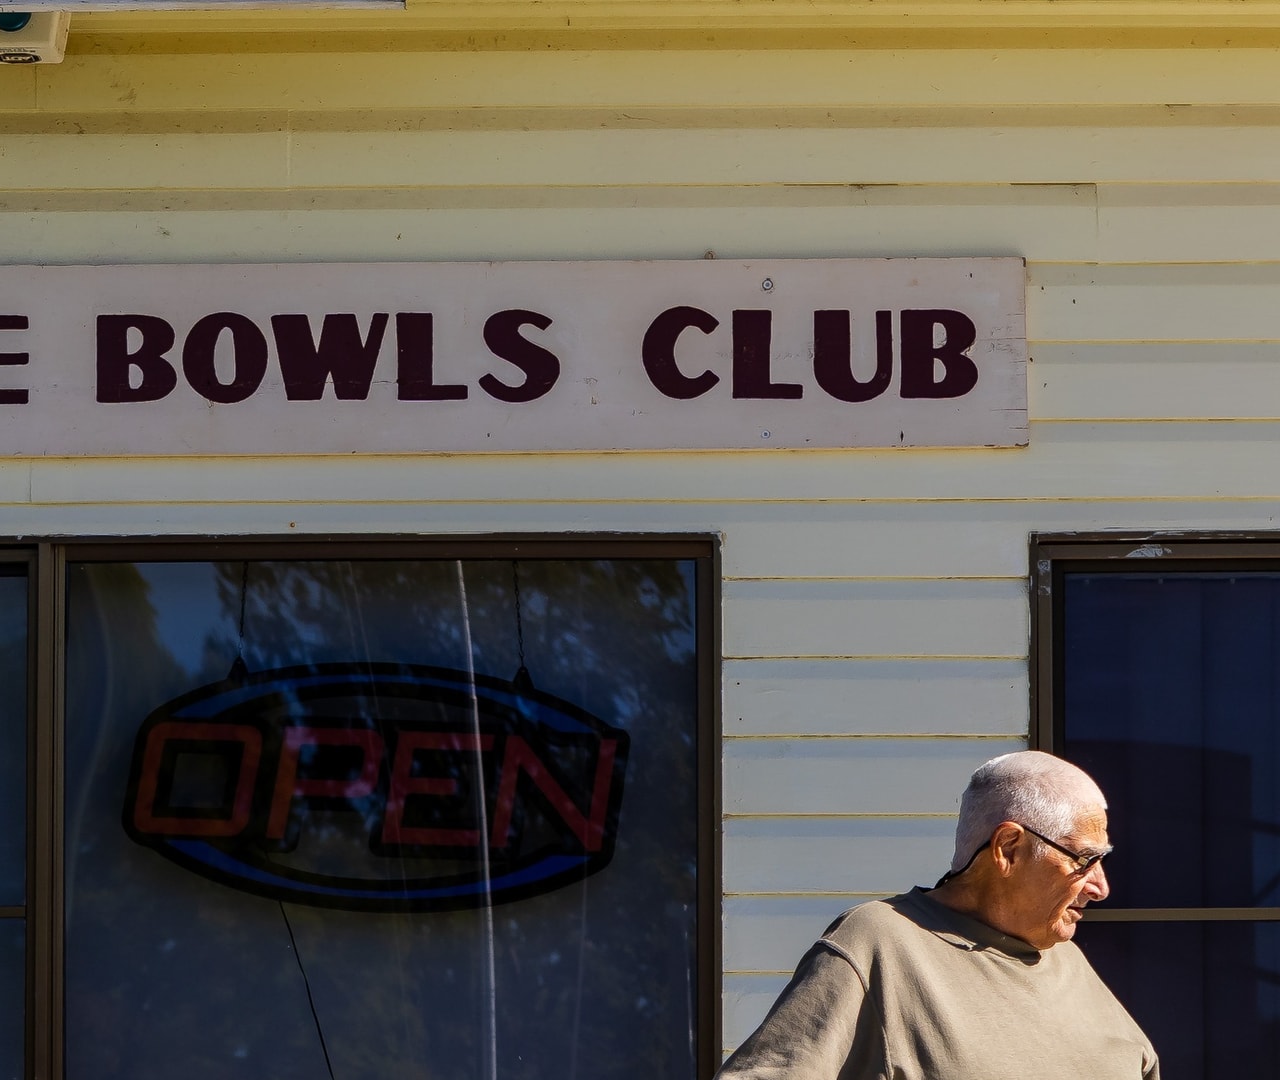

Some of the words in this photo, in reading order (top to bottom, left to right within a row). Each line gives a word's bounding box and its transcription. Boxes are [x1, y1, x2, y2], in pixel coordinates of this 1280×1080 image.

[96, 309, 561, 404] BOWLS
[641, 305, 979, 403] CLUB
[133, 721, 617, 852] OPEN
